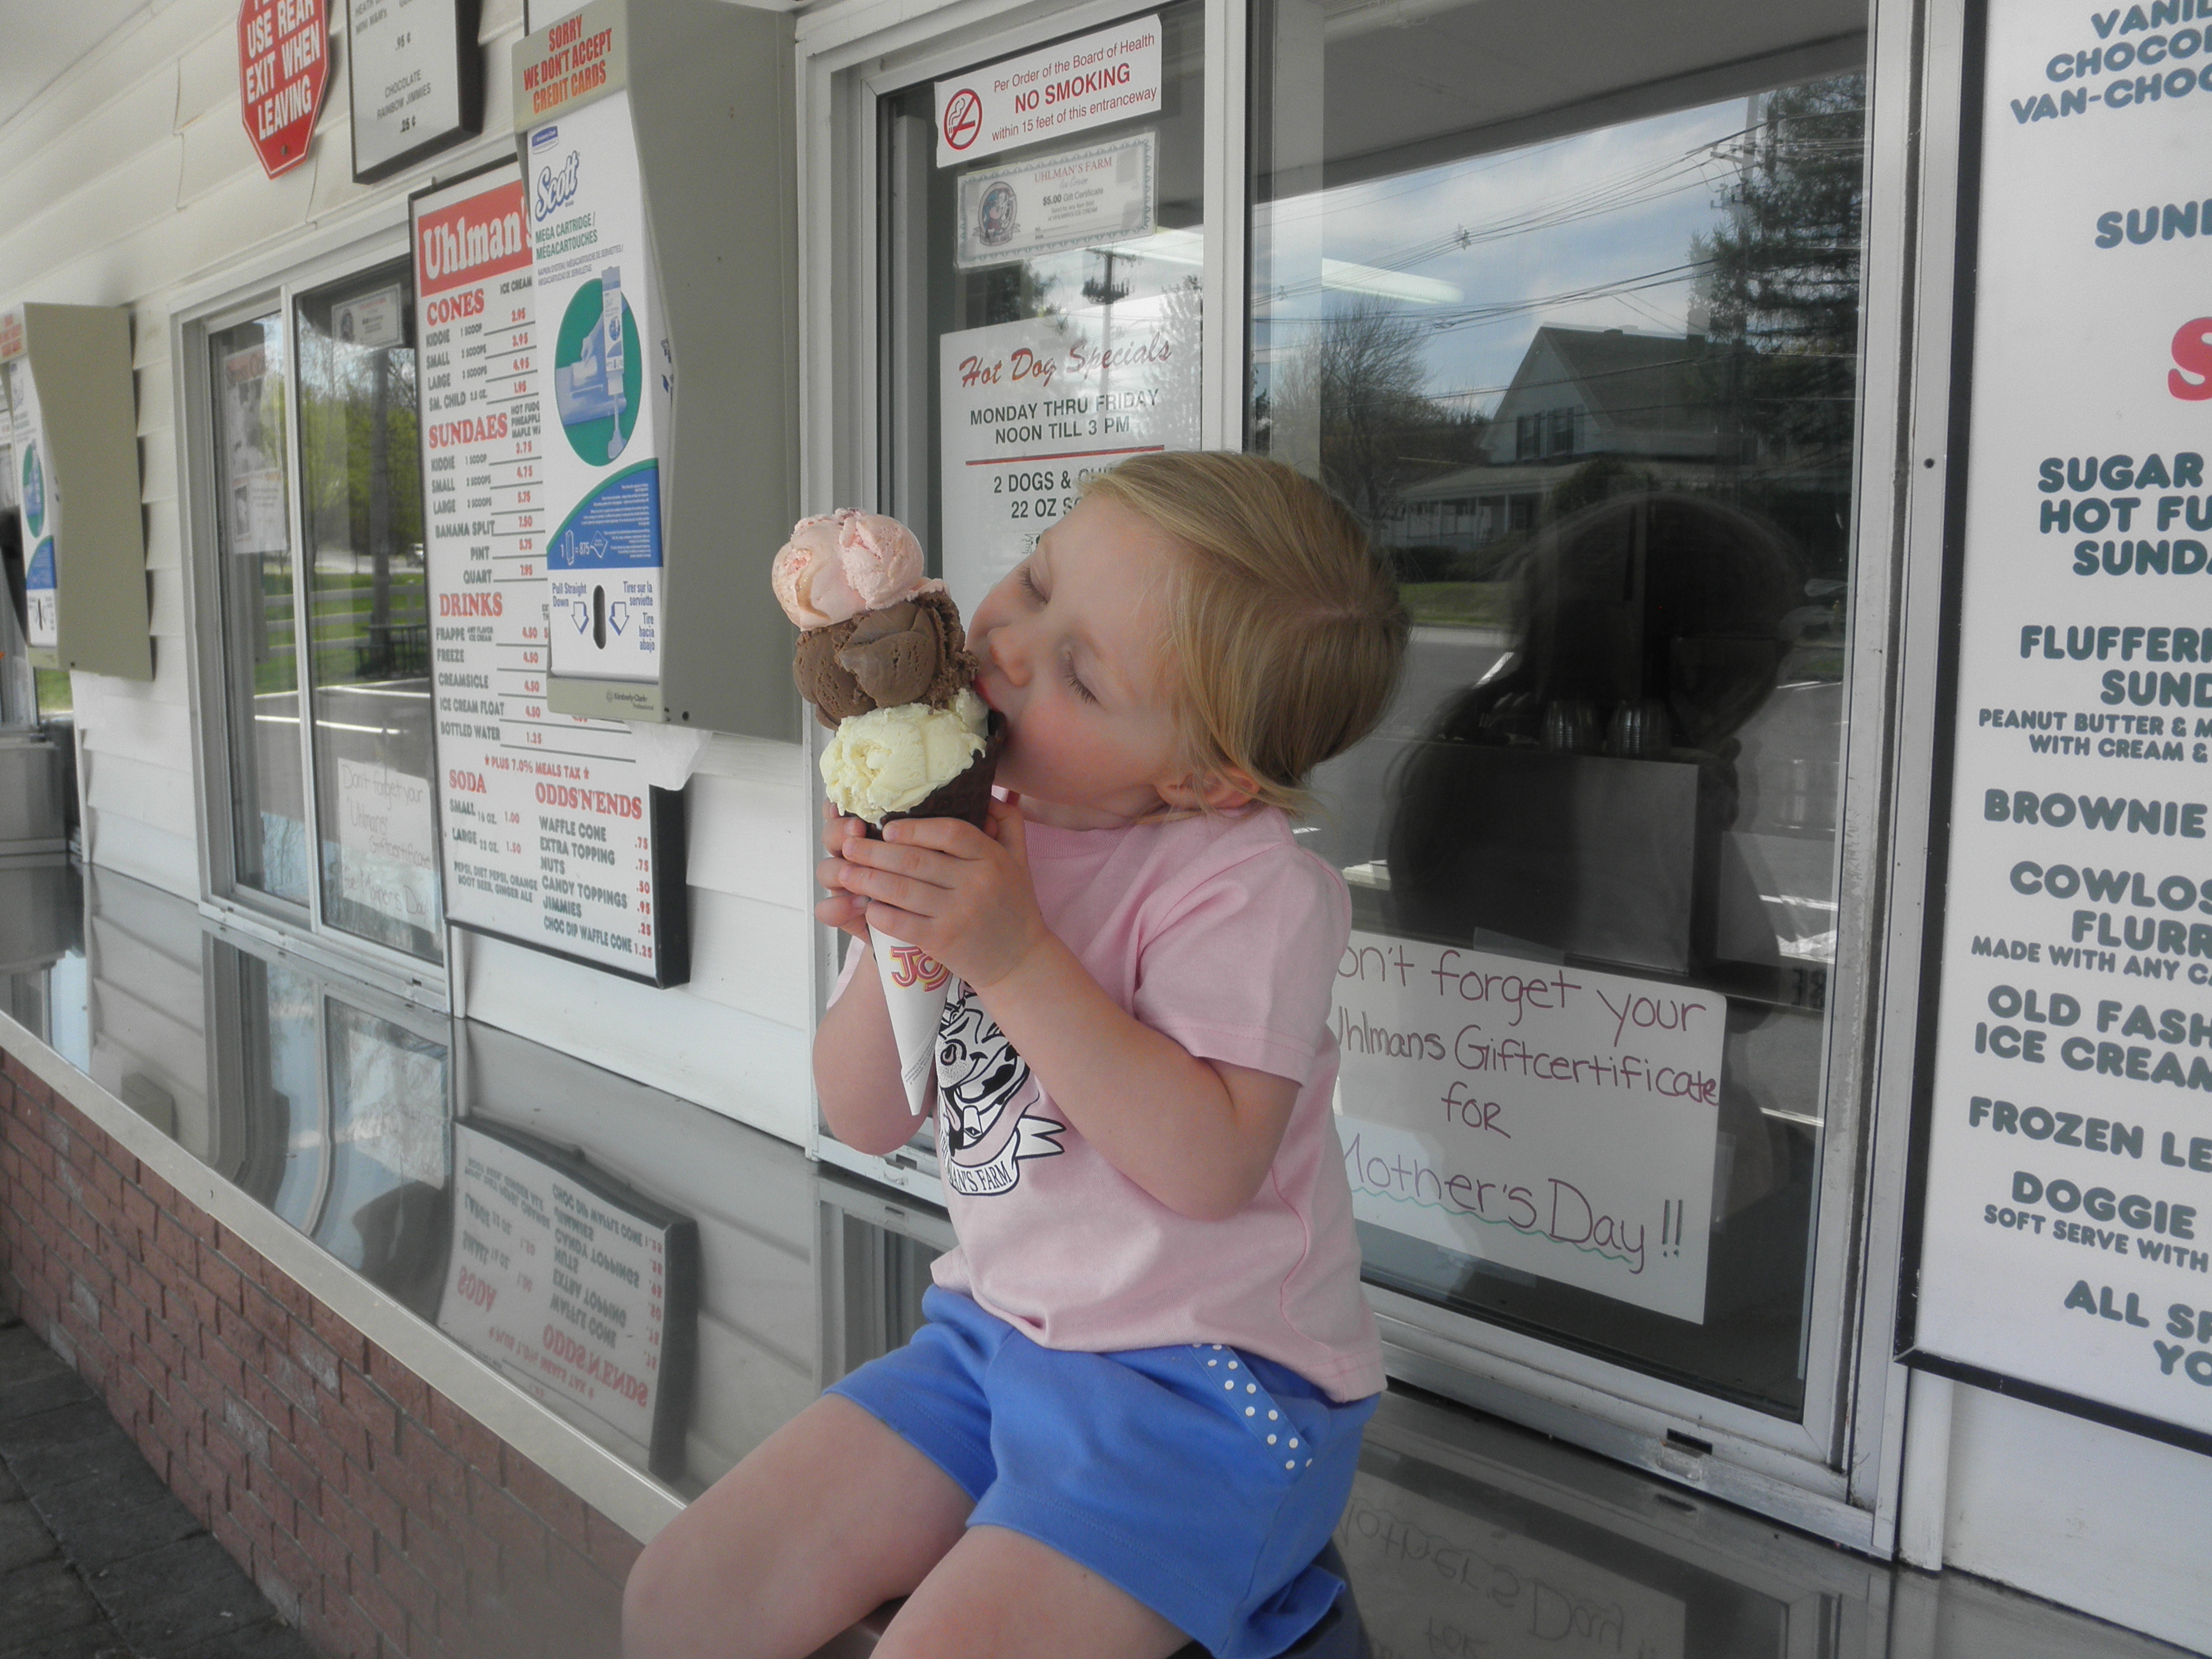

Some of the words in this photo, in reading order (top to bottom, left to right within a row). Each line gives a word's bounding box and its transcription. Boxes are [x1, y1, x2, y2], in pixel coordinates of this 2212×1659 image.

[247, 9, 272, 59] USE
[549, 14, 582, 52] SORRY
[246, 51, 275, 105] EXIT
[282, 20, 321, 80] WHEN
[523, 64, 539, 91] WE
[541, 48, 569, 84] DON'T
[572, 27, 612, 69] ACCEPT
[994, 79, 1009, 93] Per
[1012, 70, 1040, 87] Order
[1042, 63, 1052, 77] of
[1054, 60, 1070, 75] the
[1073, 47, 1104, 69] Board
[1107, 43, 1118, 58] of
[1120, 33, 1155, 55] Health
[385, 70, 421, 98] CHOCOLATE
[533, 77, 568, 114] CREDIT
[571, 59, 607, 98] CARDS
[1015, 89, 1040, 114] NO
[1045, 62, 1131, 106] SMOKING
[258, 74, 312, 142] LEAVING
[992, 125, 1019, 142] within
[1022, 119, 1034, 133] 15
[1036, 114, 1055, 129] feet
[1057, 109, 1067, 123] of
[1069, 103, 1087, 120] this
[1089, 86, 1157, 116] entranceway
[1035, 163, 1083, 183] UHLMAN'S
[1085, 156, 1113, 172] FARM
[535, 150, 579, 222] Scott
[1042, 194, 1062, 206] $5.00
[535, 227, 555, 244] MEGA
[556, 213, 592, 237] CARTRIDGE
[426, 288, 485, 327] CONES
[425, 329, 450, 348] KIDDIE
[959, 355, 1002, 388] Hot
[1011, 347, 1057, 387] Dog
[1066, 331, 1172, 380] Specials
[428, 372, 451, 391] LARGE
[970, 402, 1038, 425] MONDAY
[1044, 397, 1088, 418] THRU
[1095, 389, 1160, 412] FRIDAY
[428, 412, 508, 450] SUNDAES
[995, 424, 1042, 444] NOON
[1048, 420, 1082, 439] TILL
[1088, 419, 1097, 435] 3
[1104, 416, 1130, 434] PM
[430, 455, 455, 473] KIDDIE
[2038, 452, 2204, 493] SUGAR
[994, 476, 1002, 493] 2
[1008, 471, 1054, 492] DOGS
[1061, 470, 1071, 489] &
[433, 498, 456, 515] LARGE
[1011, 501, 1029, 518] 22
[1035, 498, 1056, 517] OZ
[2040, 497, 2141, 534] HOT
[2073, 539, 2212, 576] SUND
[463, 569, 492, 585] QUART
[552, 582, 564, 594] Pull
[564, 583, 586, 596] Straight
[623, 581, 636, 594] Tirer
[637, 583, 646, 593] sur
[647, 581, 653, 593] la
[439, 591, 503, 618] DRINKS
[552, 595, 569, 608] Down
[629, 594, 653, 607] serviette
[639, 625, 654, 638] hacia
[642, 612, 654, 625] Tire
[436, 648, 465, 663] FREEZE
[639, 638, 655, 653] abajo
[438, 672, 489, 689] CREAMSICLE
[439, 697, 452, 712] ICE
[453, 698, 479, 714] CREAM
[480, 701, 505, 716] FLOAT
[440, 721, 473, 738] BOTTLED
[473, 724, 501, 741] WATER
[1979, 708, 2068, 731] PEANUT
[2074, 712, 2164, 736] BUTTER
[2171, 716, 2187, 737] &
[2029, 734, 2090, 756] WITH
[2098, 738, 2184, 762] CREAM
[2192, 743, 2208, 763] &
[449, 769, 487, 794] SODA
[491, 755, 510, 771] PLUS
[535, 761, 562, 778] MEALS
[563, 765, 580, 780] TAX
[450, 798, 476, 816] SMALL
[535, 782, 642, 820] ODDS'N'ENDS
[1984, 788, 2208, 839] BROWNIE
[452, 827, 477, 845] LARGE
[539, 815, 575, 837] WAFFLE
[578, 823, 607, 842] CONE
[539, 836, 569, 856] EXTRA
[571, 843, 615, 866] TOPPING
[540, 856, 565, 875] NUTS
[541, 876, 575, 896] CANDY
[577, 883, 628, 909] TOPPINGS
[543, 895, 582, 918] JIMMIES
[544, 915, 565, 934] CHOC
[566, 920, 578, 938] DIP
[580, 925, 608, 947] WAFFLE
[610, 934, 632, 954] CONE
[1971, 935, 2041, 963] MADE
[2048, 944, 2116, 974] WITH
[2123, 954, 2180, 981] ANY
[1338, 944, 1415, 987] on't
[1431, 949, 1582, 1026] forget
[1597, 989, 1706, 1047] your
[1987, 984, 2082, 1027] OLD
[1339, 1006, 1445, 1060] hlmans
[1975, 1021, 2047, 1064] ICE
[1969, 1095, 2144, 1160] FROZEN
[975, 1161, 1013, 1191] FARM
[2012, 1170, 2197, 1240] DOGGIE
[1984, 1204, 2046, 1235] SOFT
[2053, 1220, 2129, 1255] SERVE
[2137, 1238, 2209, 1273] WITH
[2064, 1279, 2150, 1328] ALL
